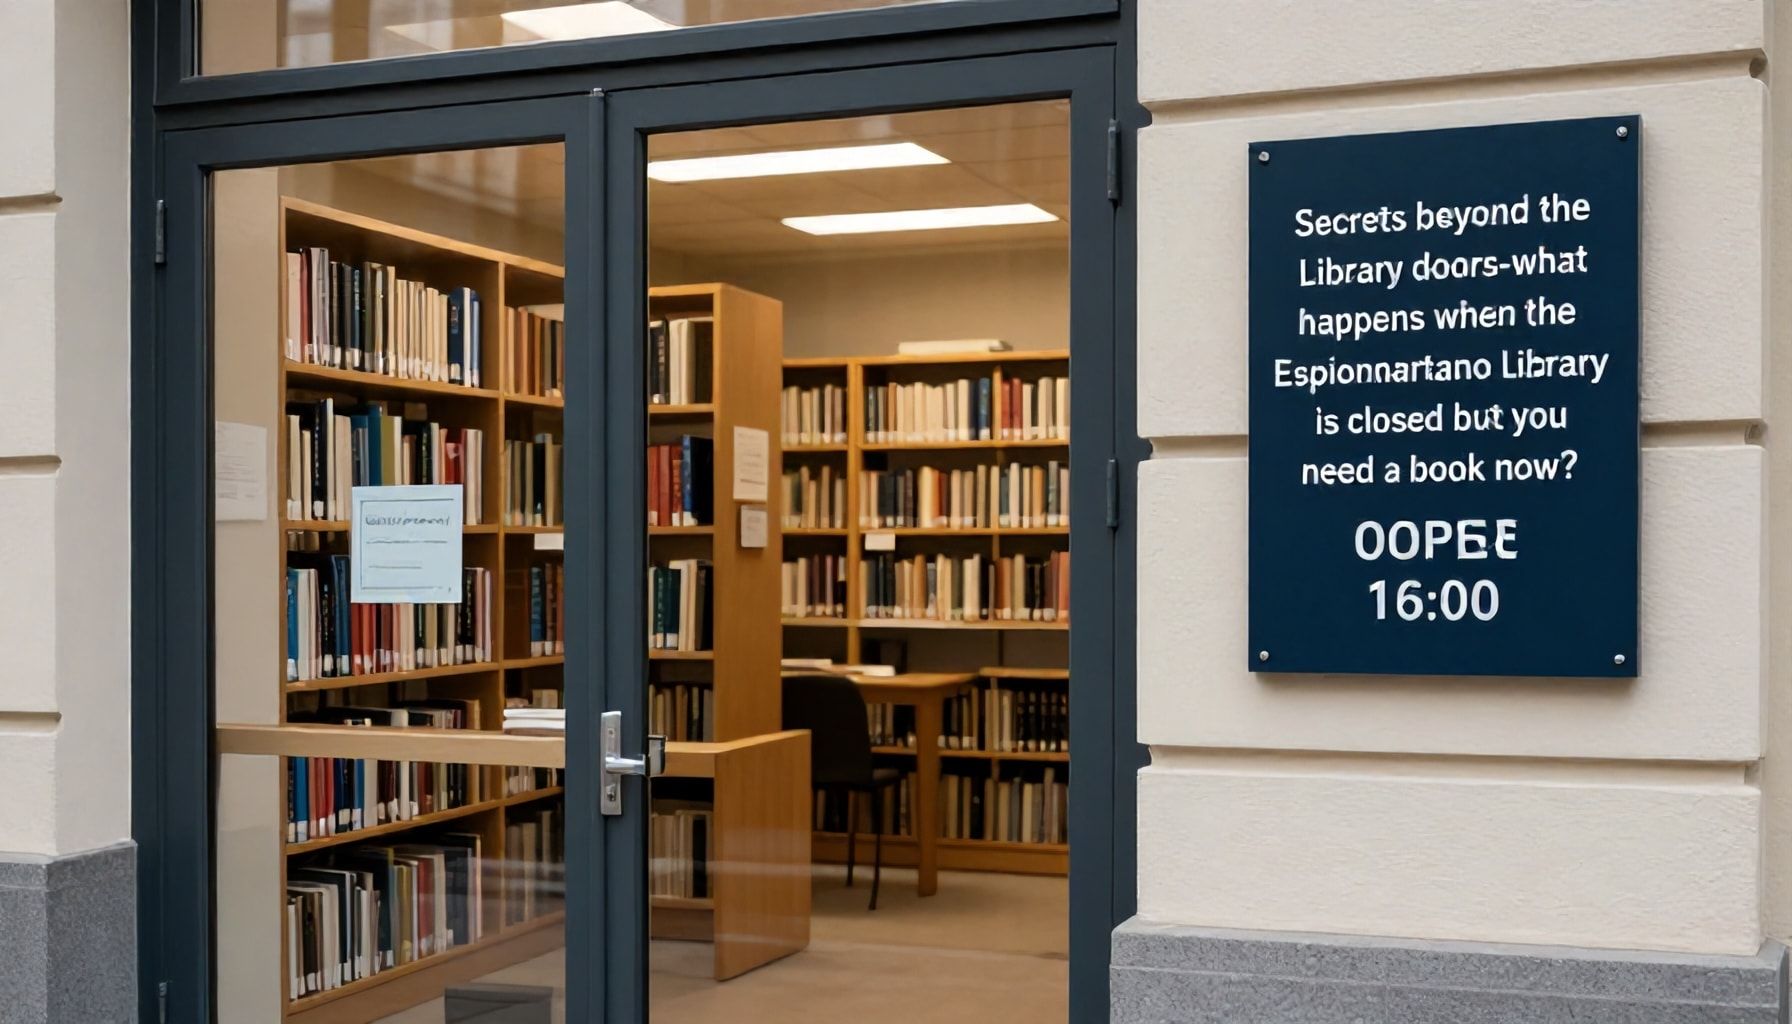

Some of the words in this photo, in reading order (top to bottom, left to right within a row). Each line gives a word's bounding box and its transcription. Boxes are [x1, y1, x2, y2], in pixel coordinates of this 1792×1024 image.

[1294, 206, 1407, 238] Secrets
[1416, 194, 1529, 236] beyond
[1538, 193, 1591, 223] the
[1299, 256, 1404, 290] Library
[1298, 307, 1426, 342] happens
[1434, 299, 1516, 330] when
[1524, 295, 1577, 327] the
[1501, 348, 1610, 385] Library
[1315, 406, 1340, 435] is
[1347, 402, 1443, 434] closed
[1453, 401, 1505, 432] but
[1511, 406, 1568, 438] you
[1302, 454, 1374, 486] need
[1383, 461, 1401, 484] a
[1410, 452, 1486, 484] book
[1495, 449, 1579, 482] now?
[1369, 578, 1500, 622] 16:00
